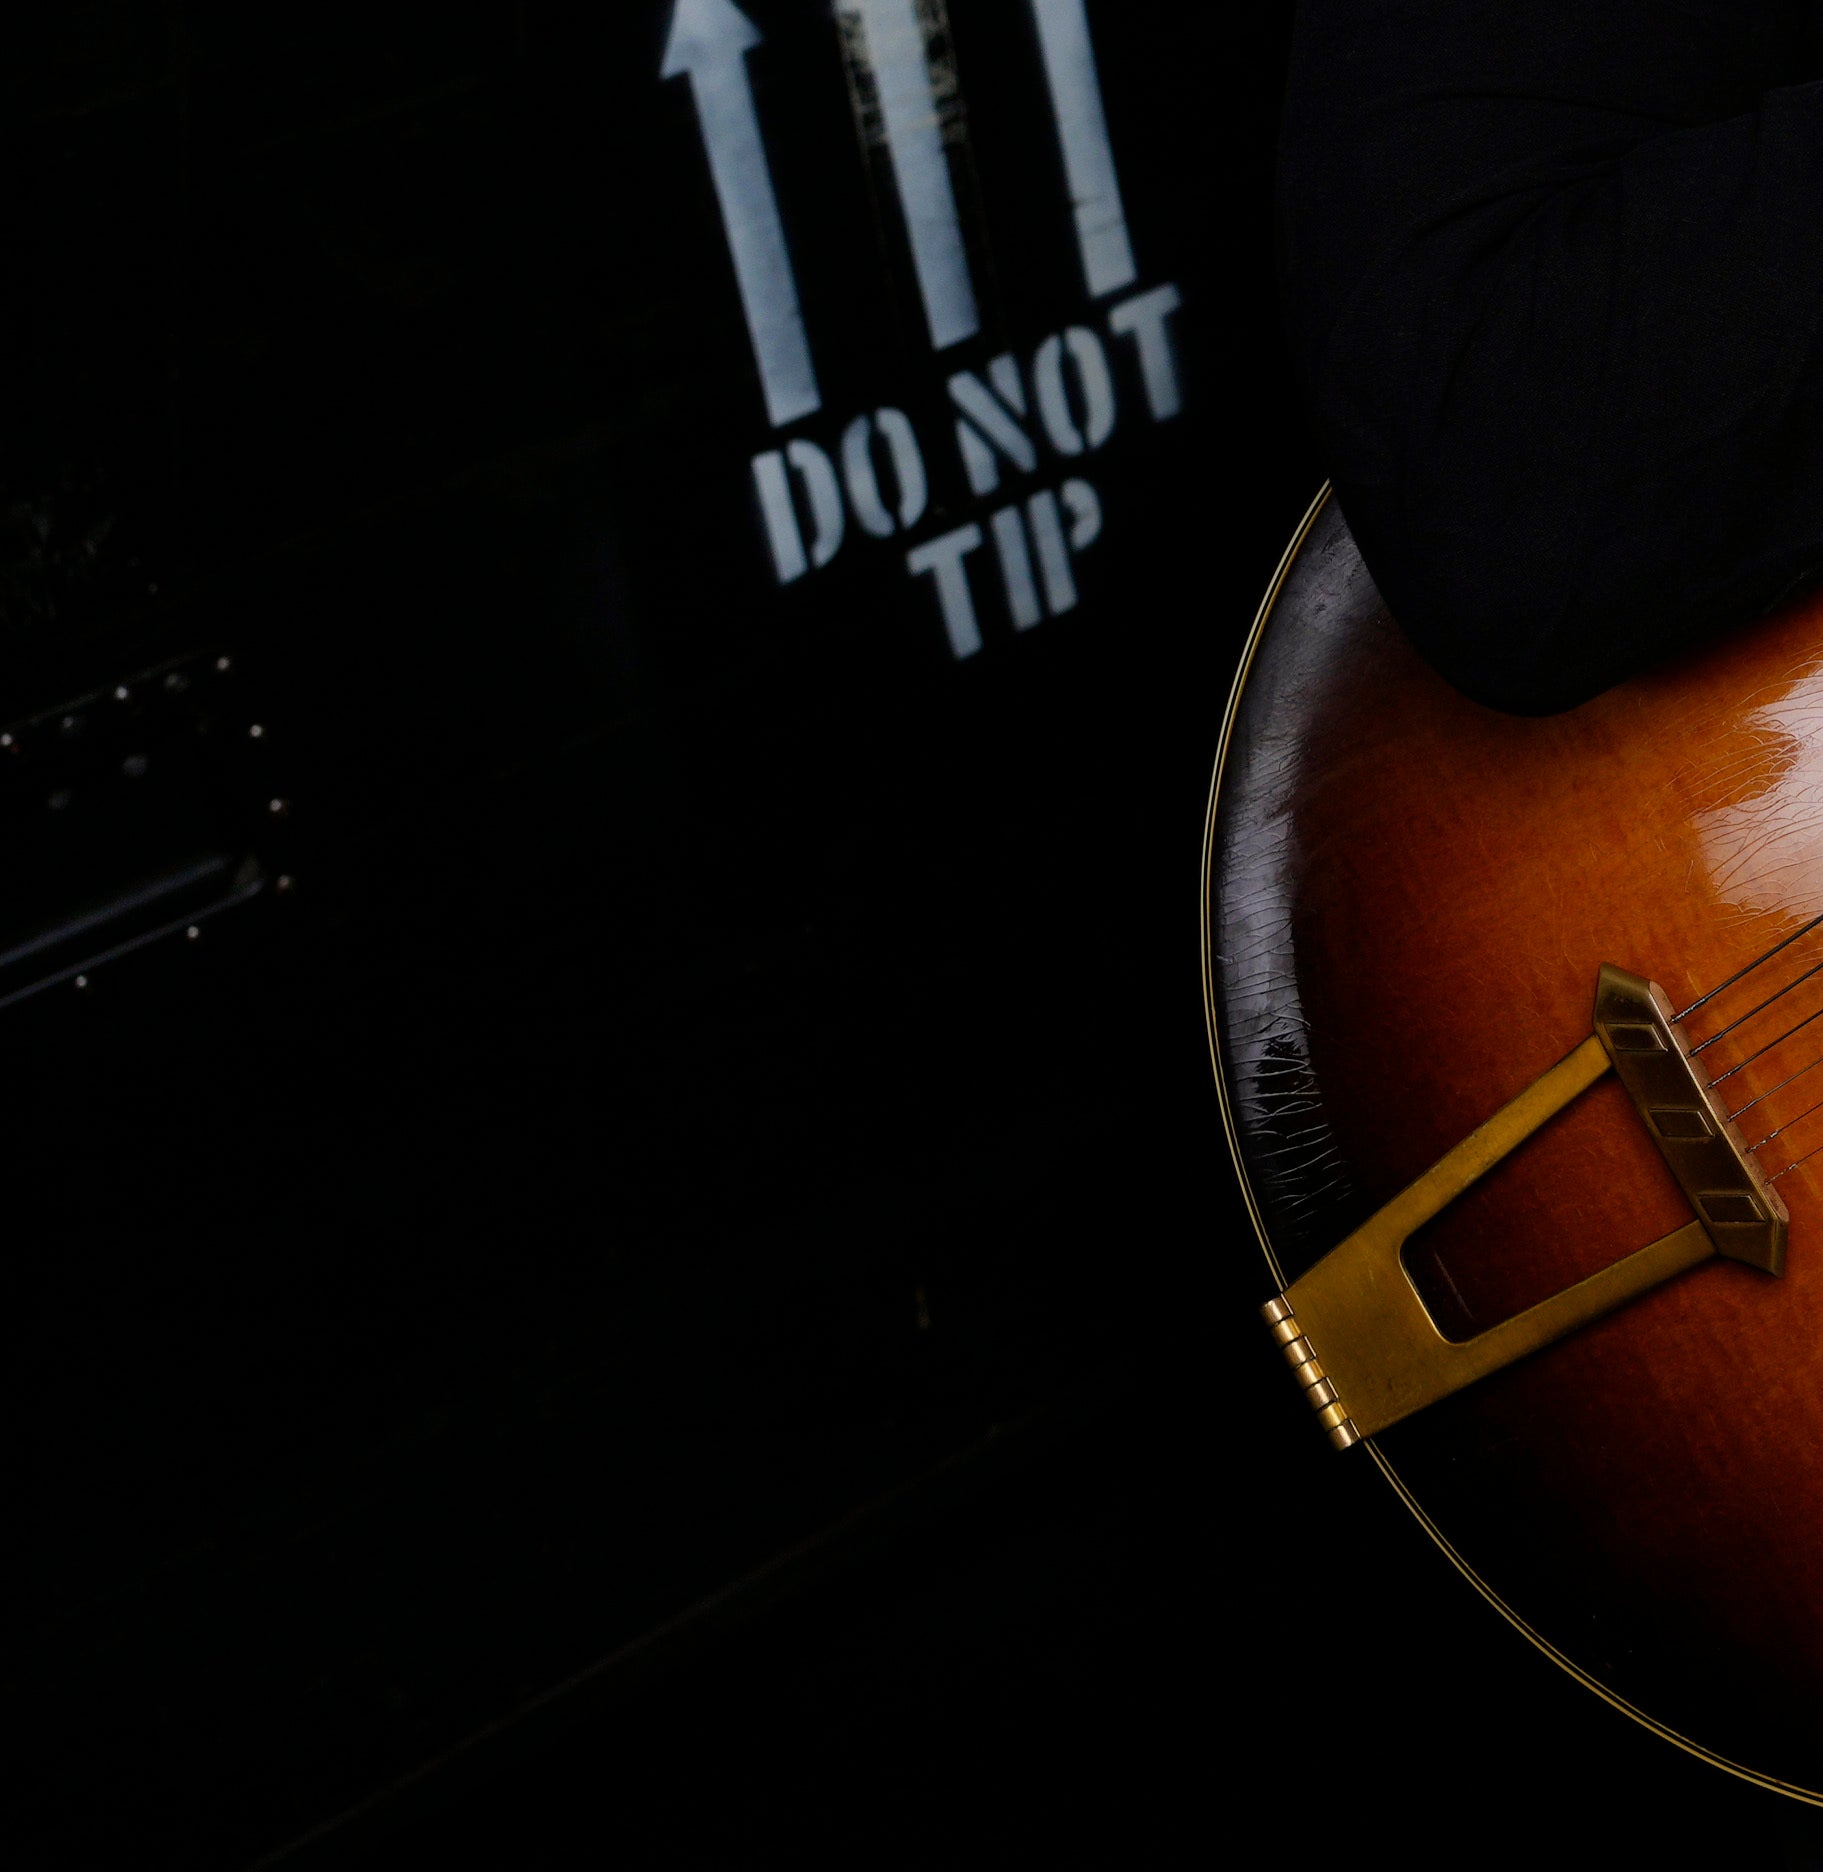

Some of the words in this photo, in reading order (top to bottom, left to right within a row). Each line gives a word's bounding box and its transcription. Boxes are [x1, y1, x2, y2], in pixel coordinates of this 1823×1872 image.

[750, 408, 928, 585] DO
[947, 282, 1182, 495] NOT
[906, 478, 1100, 660] TIP
